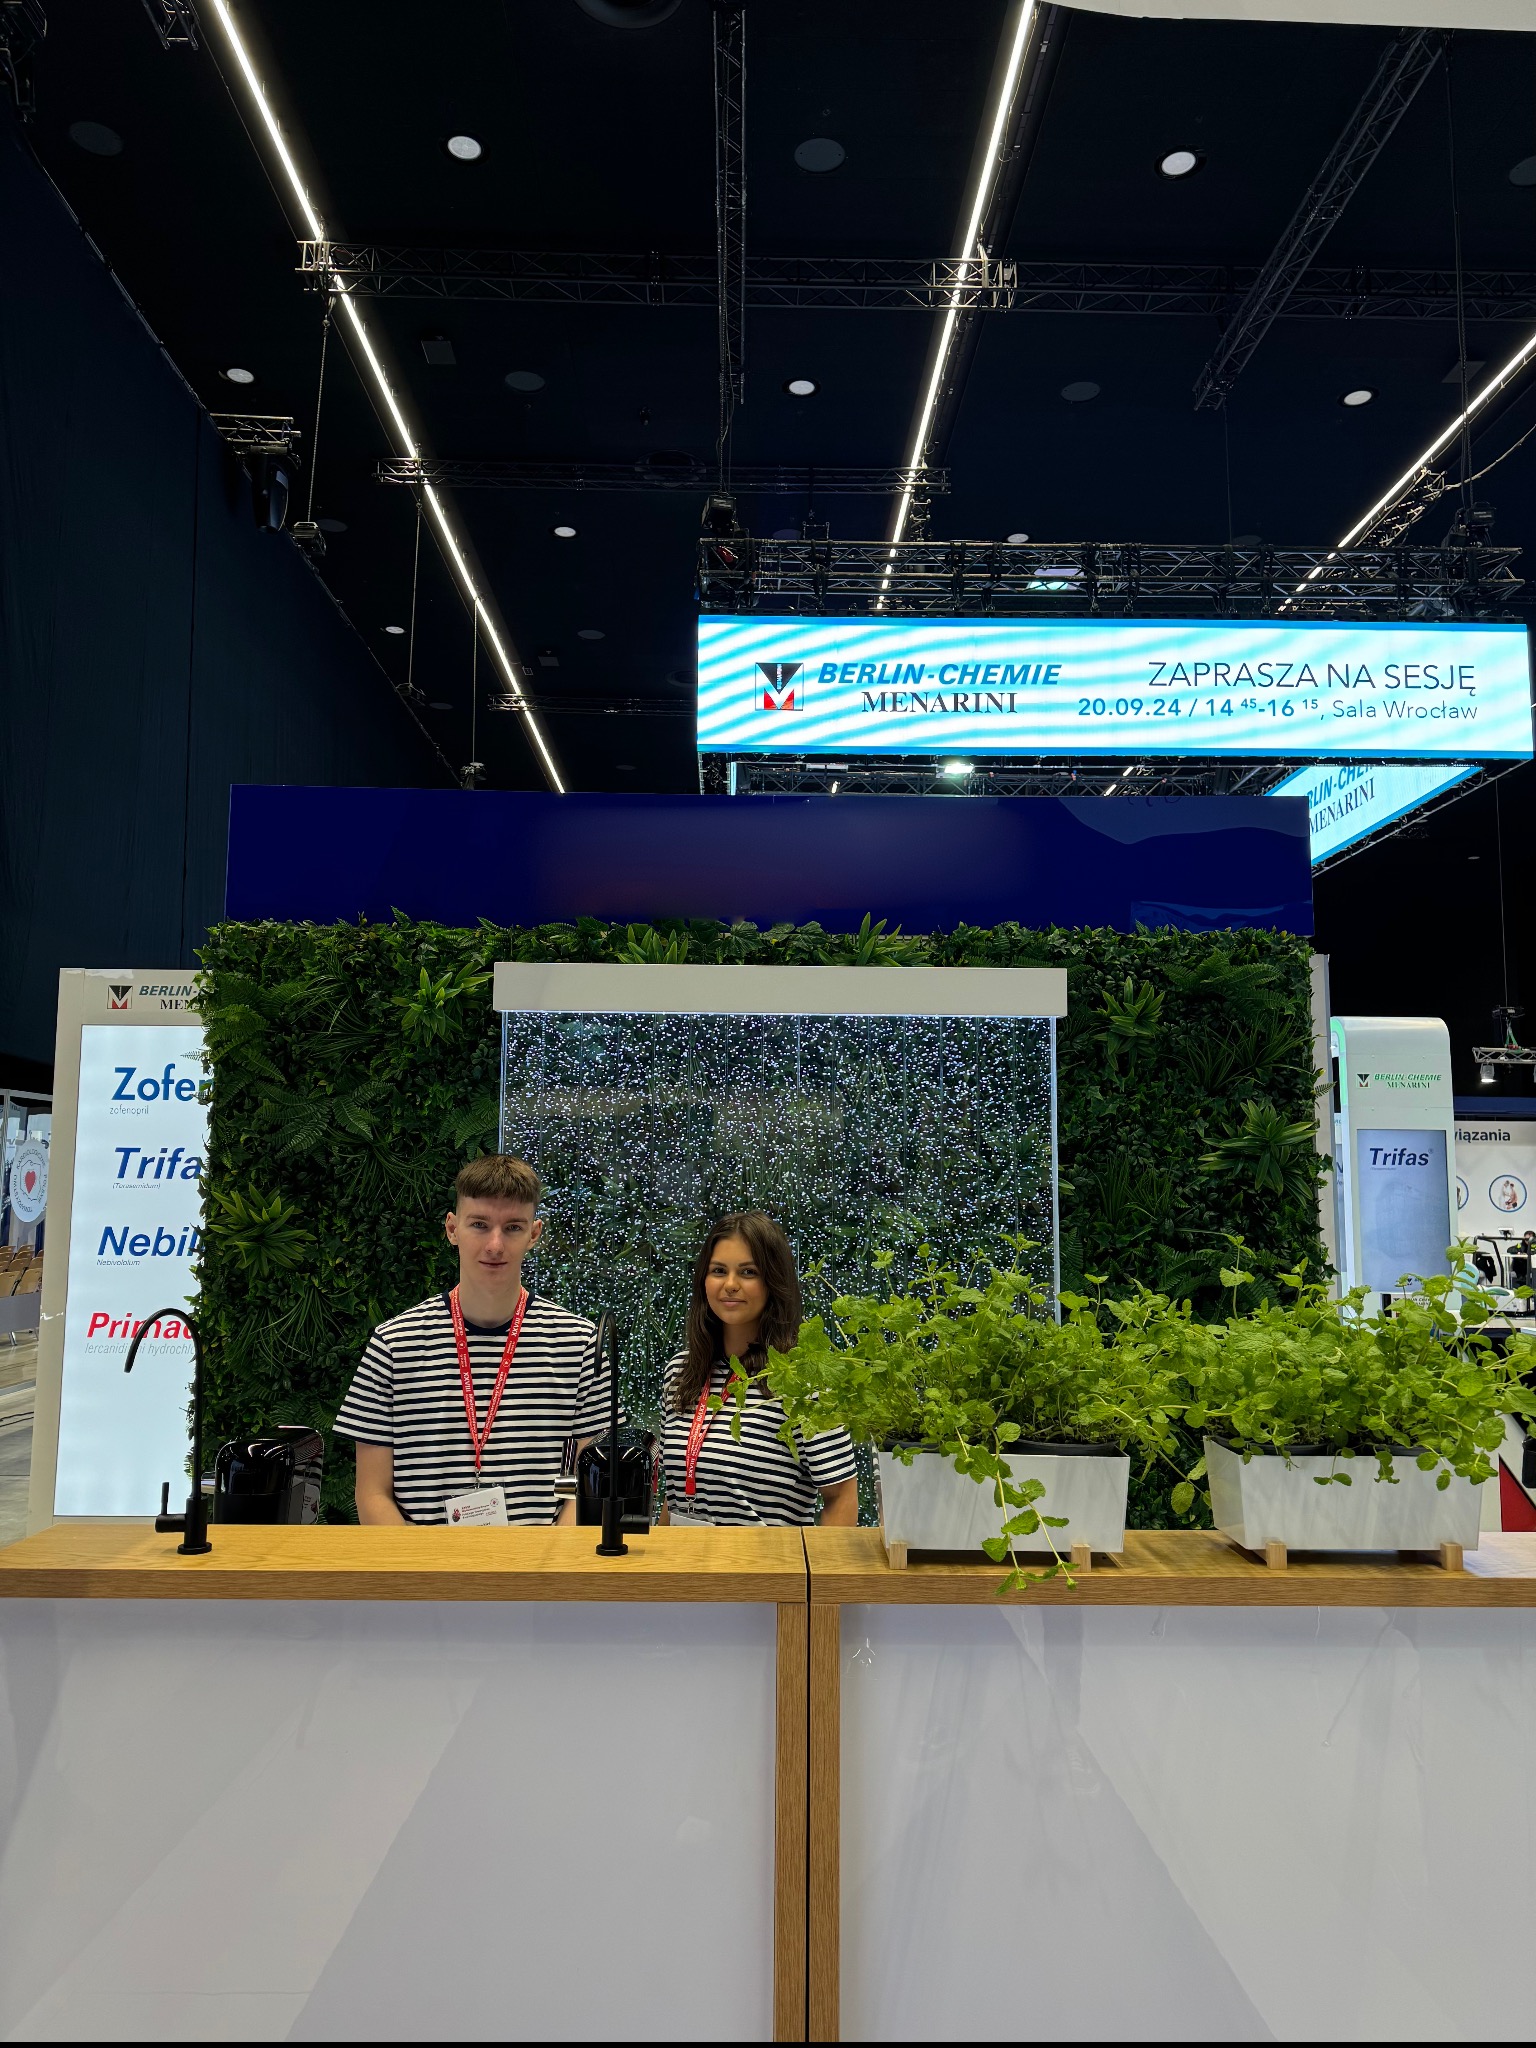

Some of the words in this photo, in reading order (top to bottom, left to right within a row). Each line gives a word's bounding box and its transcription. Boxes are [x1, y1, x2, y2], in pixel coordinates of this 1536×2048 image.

[818, 662, 1062, 685] BERLIN-CHEMIE
[1148, 661, 1318, 688] ZAPRASZA
[1328, 664, 1376, 689] NA
[1385, 664, 1477, 697] SESJĘ
[861, 691, 1018, 714] MENARINI
[1078, 698, 1182, 717] 20.09.24
[1188, 697, 1199, 718] /
[1206, 698, 1234, 717] 14
[1333, 700, 1377, 719] Sala
[1383, 700, 1478, 720] Wrocław
[1310, 776, 1375, 837] MENARINI
